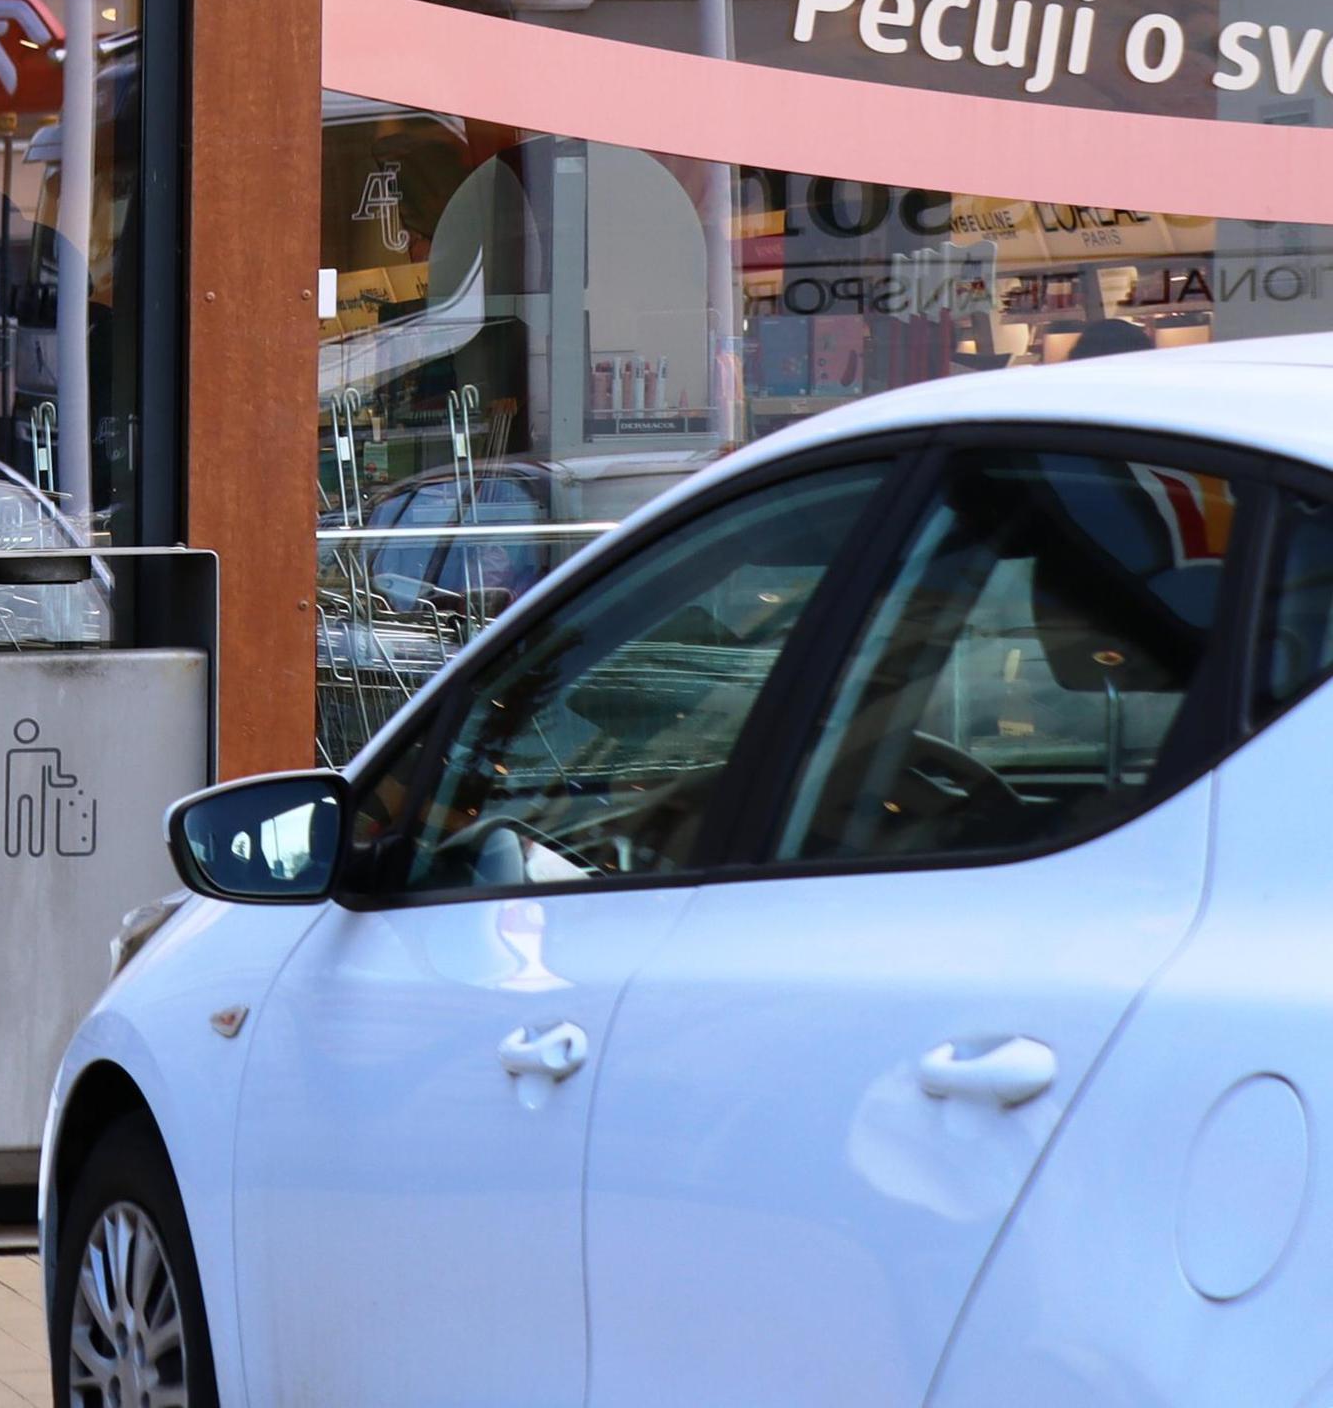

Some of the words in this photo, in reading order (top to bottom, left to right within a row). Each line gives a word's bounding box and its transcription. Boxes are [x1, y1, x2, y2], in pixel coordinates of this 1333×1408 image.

[1125, 13, 1184, 84] o
[1212, 21, 1333, 95] sv
[1082, 231, 1122, 248] PARIS
